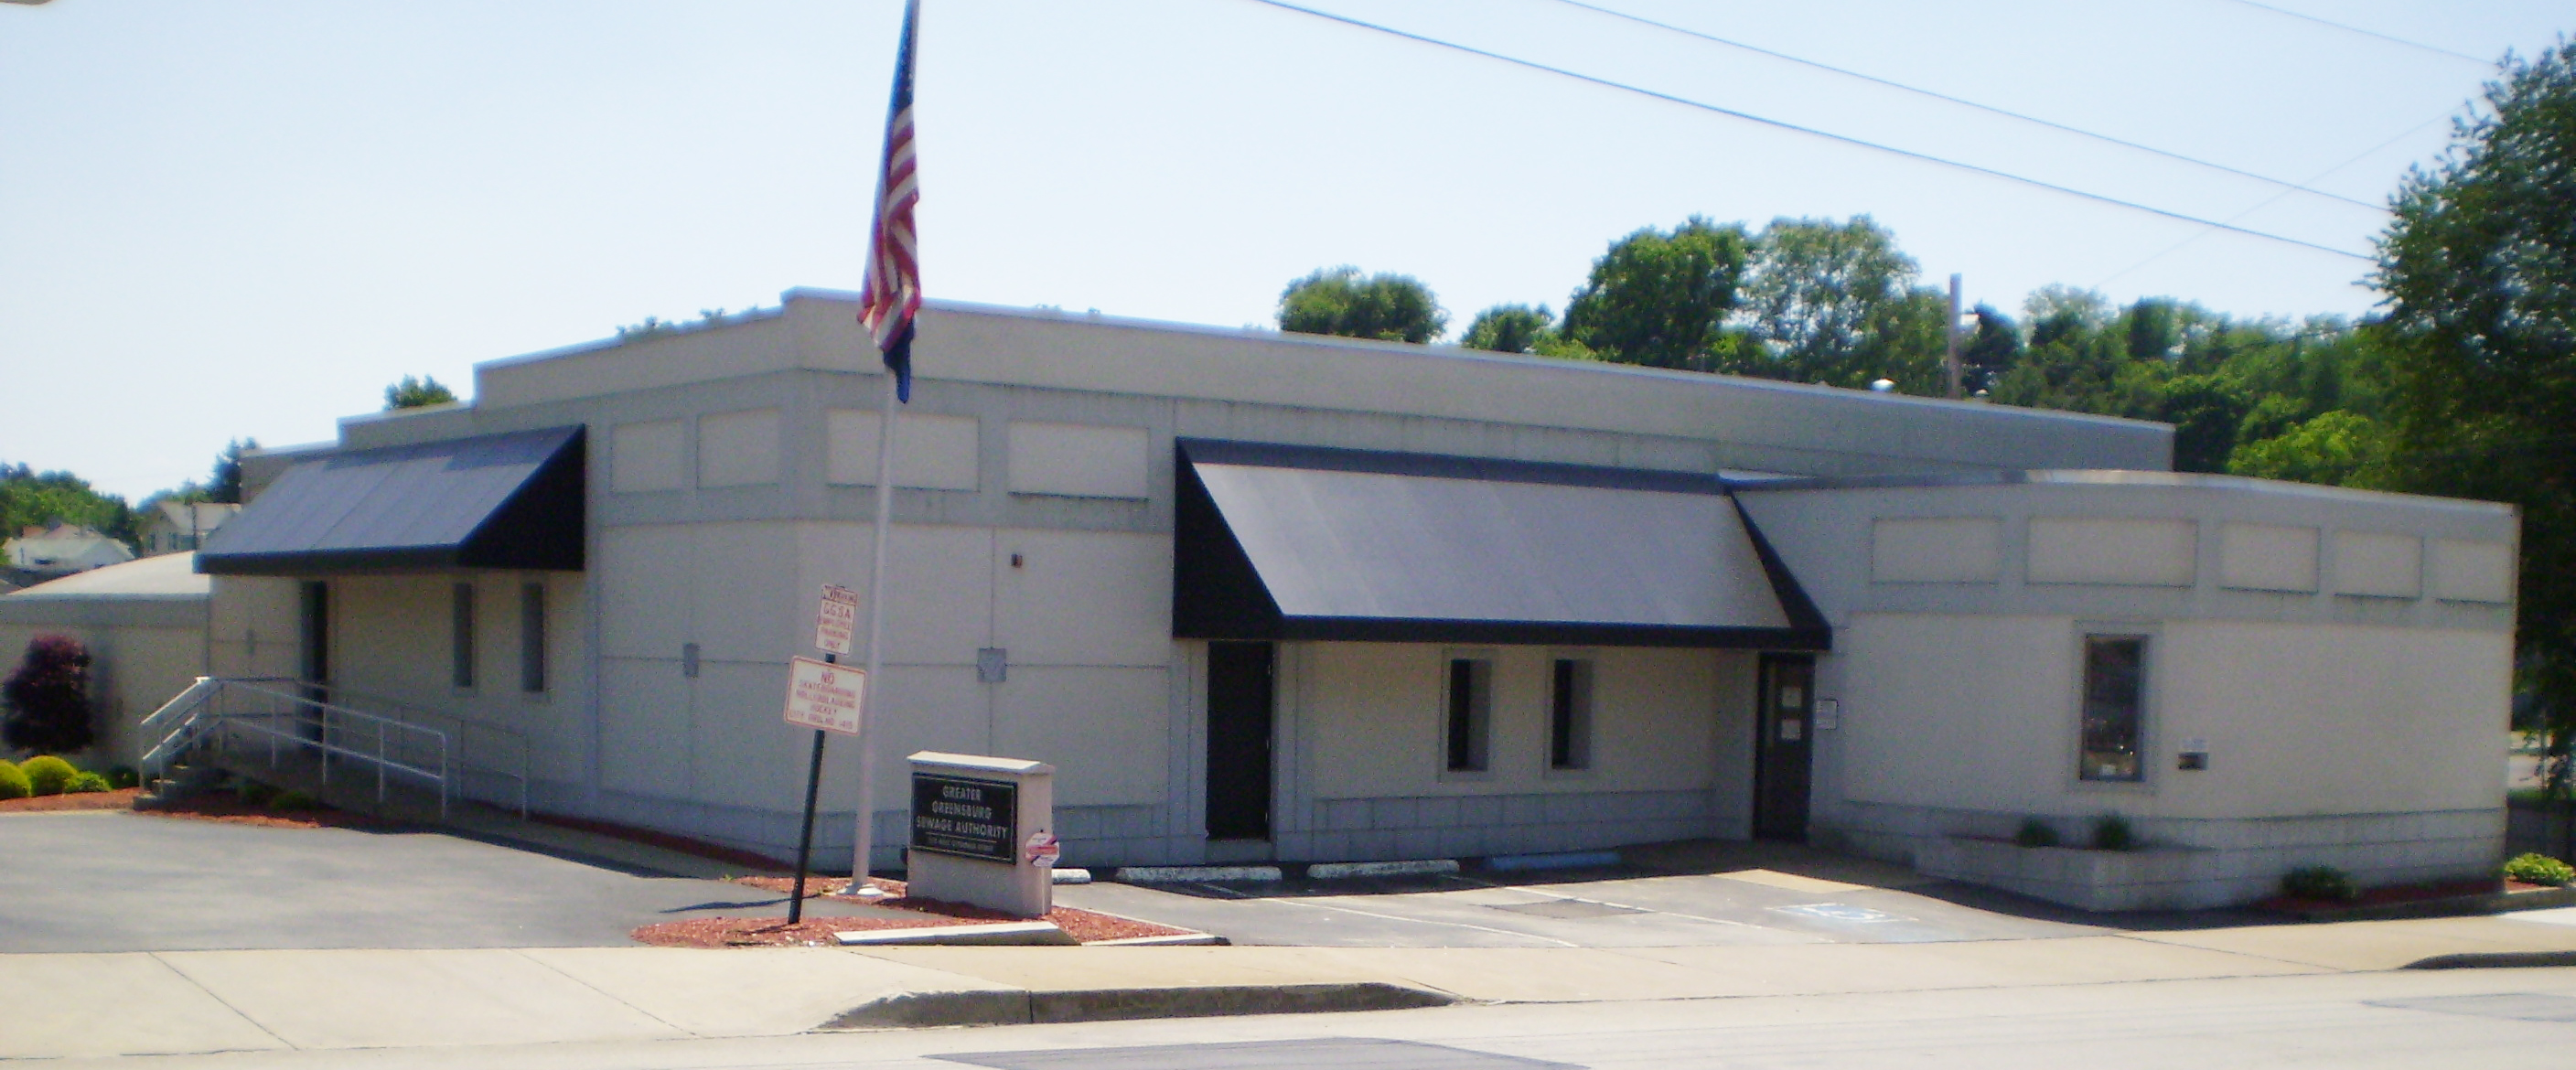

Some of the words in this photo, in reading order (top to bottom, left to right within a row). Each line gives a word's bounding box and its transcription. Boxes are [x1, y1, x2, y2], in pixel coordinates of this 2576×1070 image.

[821, 671, 834, 685] NO
[942, 786, 982, 801] GREATER
[932, 800, 992, 819] GREENSBURG
[916, 815, 952, 831] SEWAGE
[955, 821, 1008, 839] AUTHORITY
